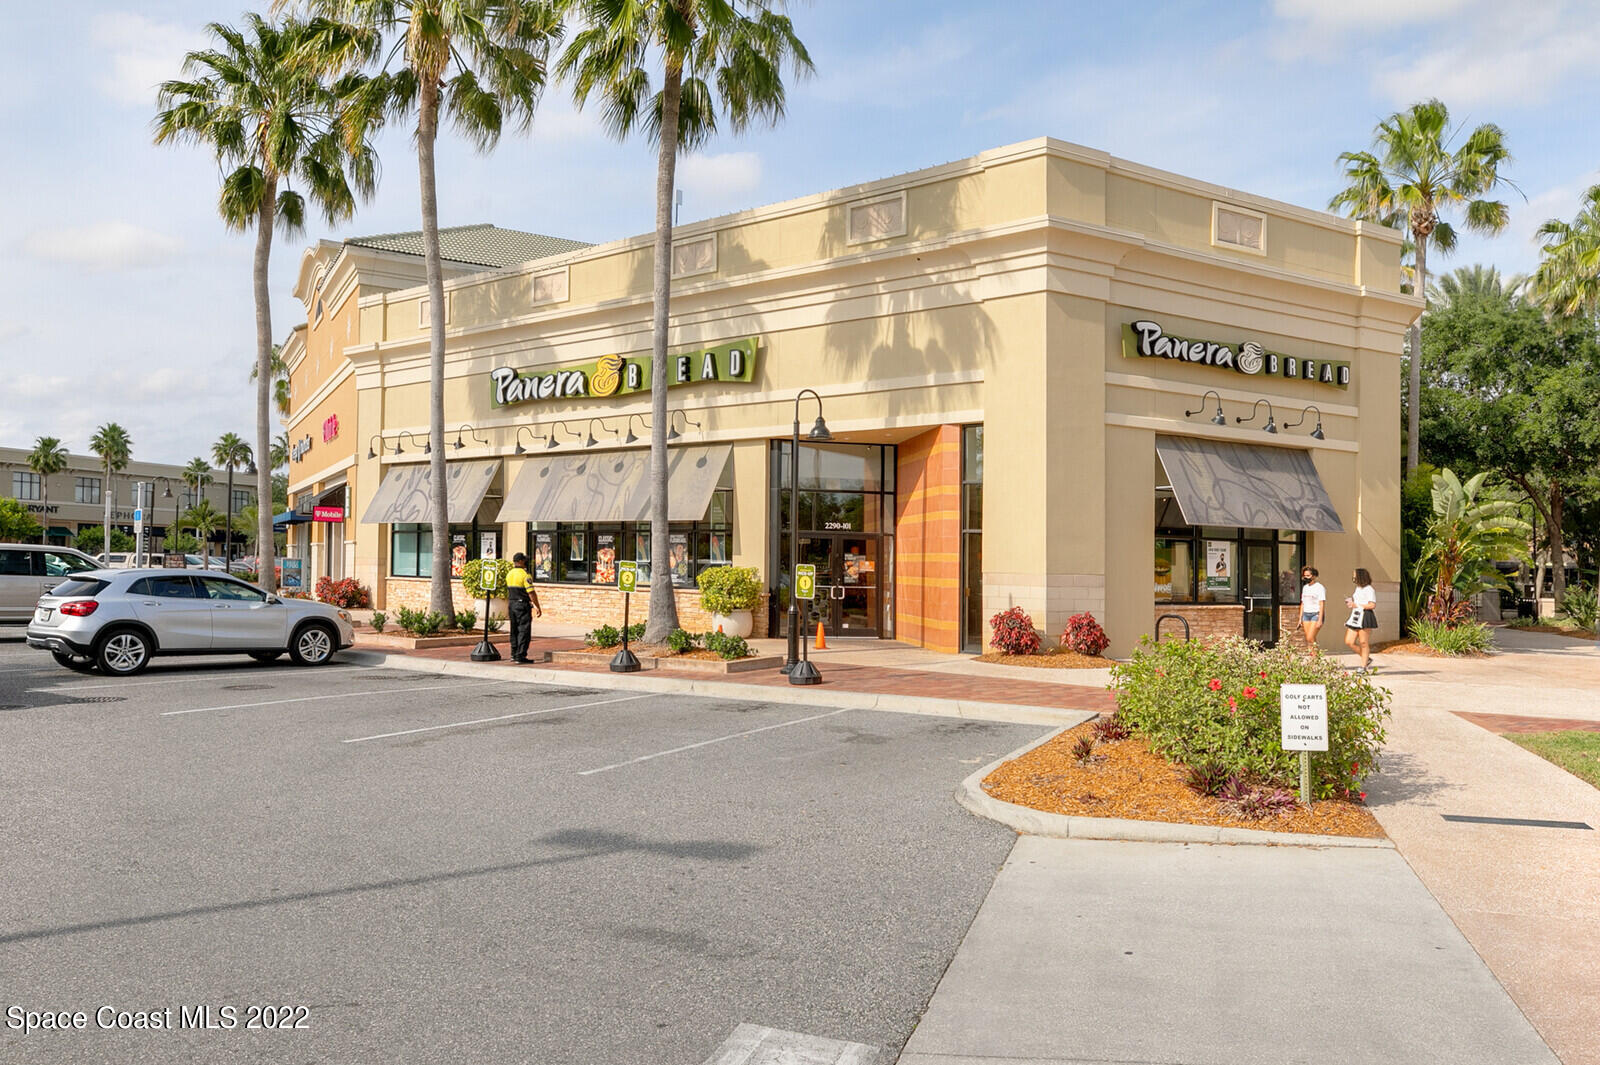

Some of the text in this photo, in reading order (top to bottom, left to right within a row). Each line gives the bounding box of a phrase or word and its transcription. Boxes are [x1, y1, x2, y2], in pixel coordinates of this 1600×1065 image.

[1133, 321, 1349, 384] Panera BREAD
[491, 350, 745, 404] Panera BEAD
[28, 504, 59, 513] RYANT
[824, 522, 852, 530] 2290-101
